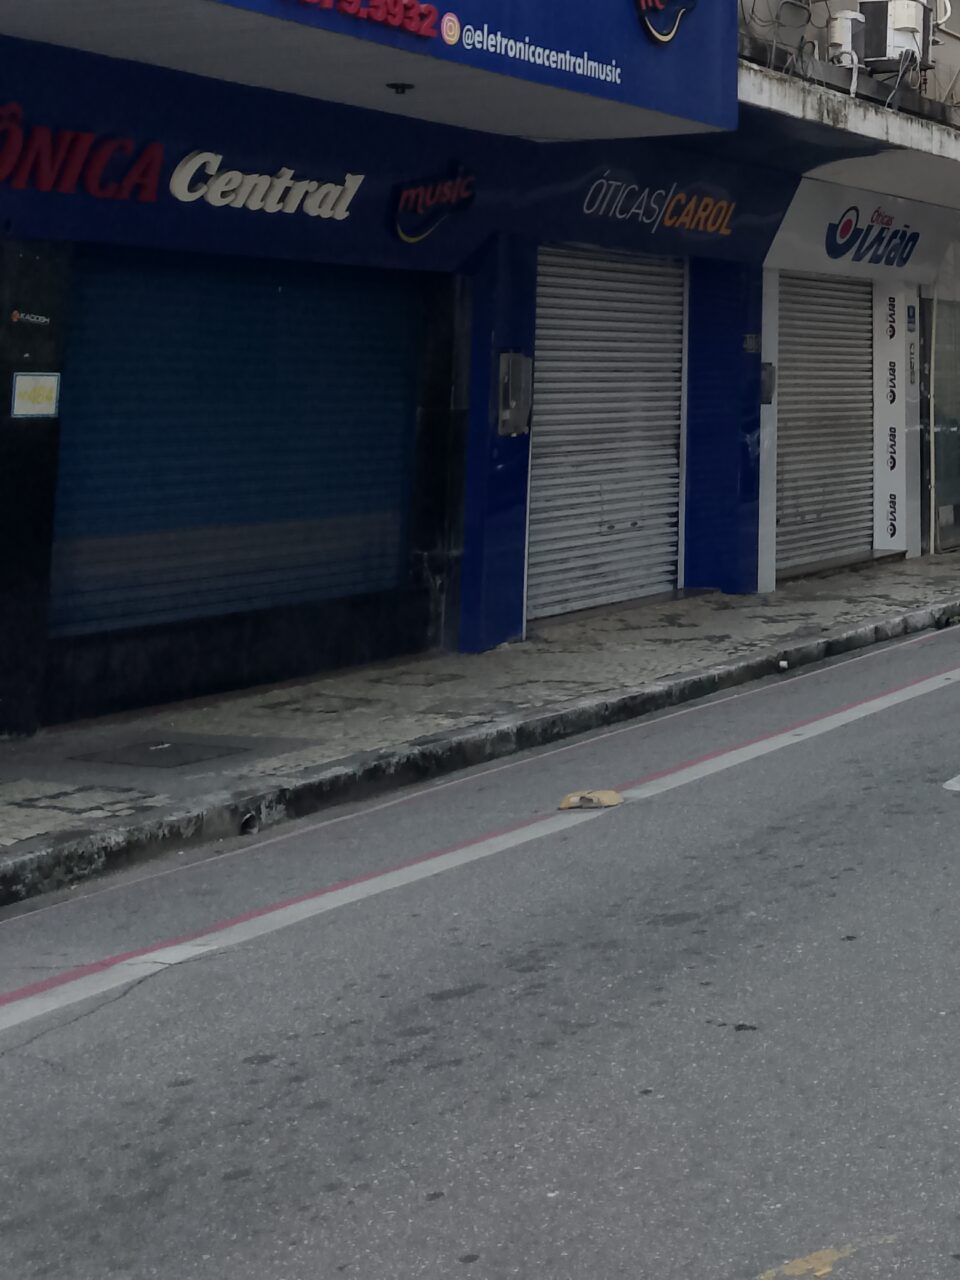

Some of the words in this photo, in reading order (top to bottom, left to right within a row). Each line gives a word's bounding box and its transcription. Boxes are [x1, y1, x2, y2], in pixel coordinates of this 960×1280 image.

[461, 25, 622, 86] @eletronicacentralmusic
[169, 150, 365, 221] Central
[396, 170, 476, 216] music
